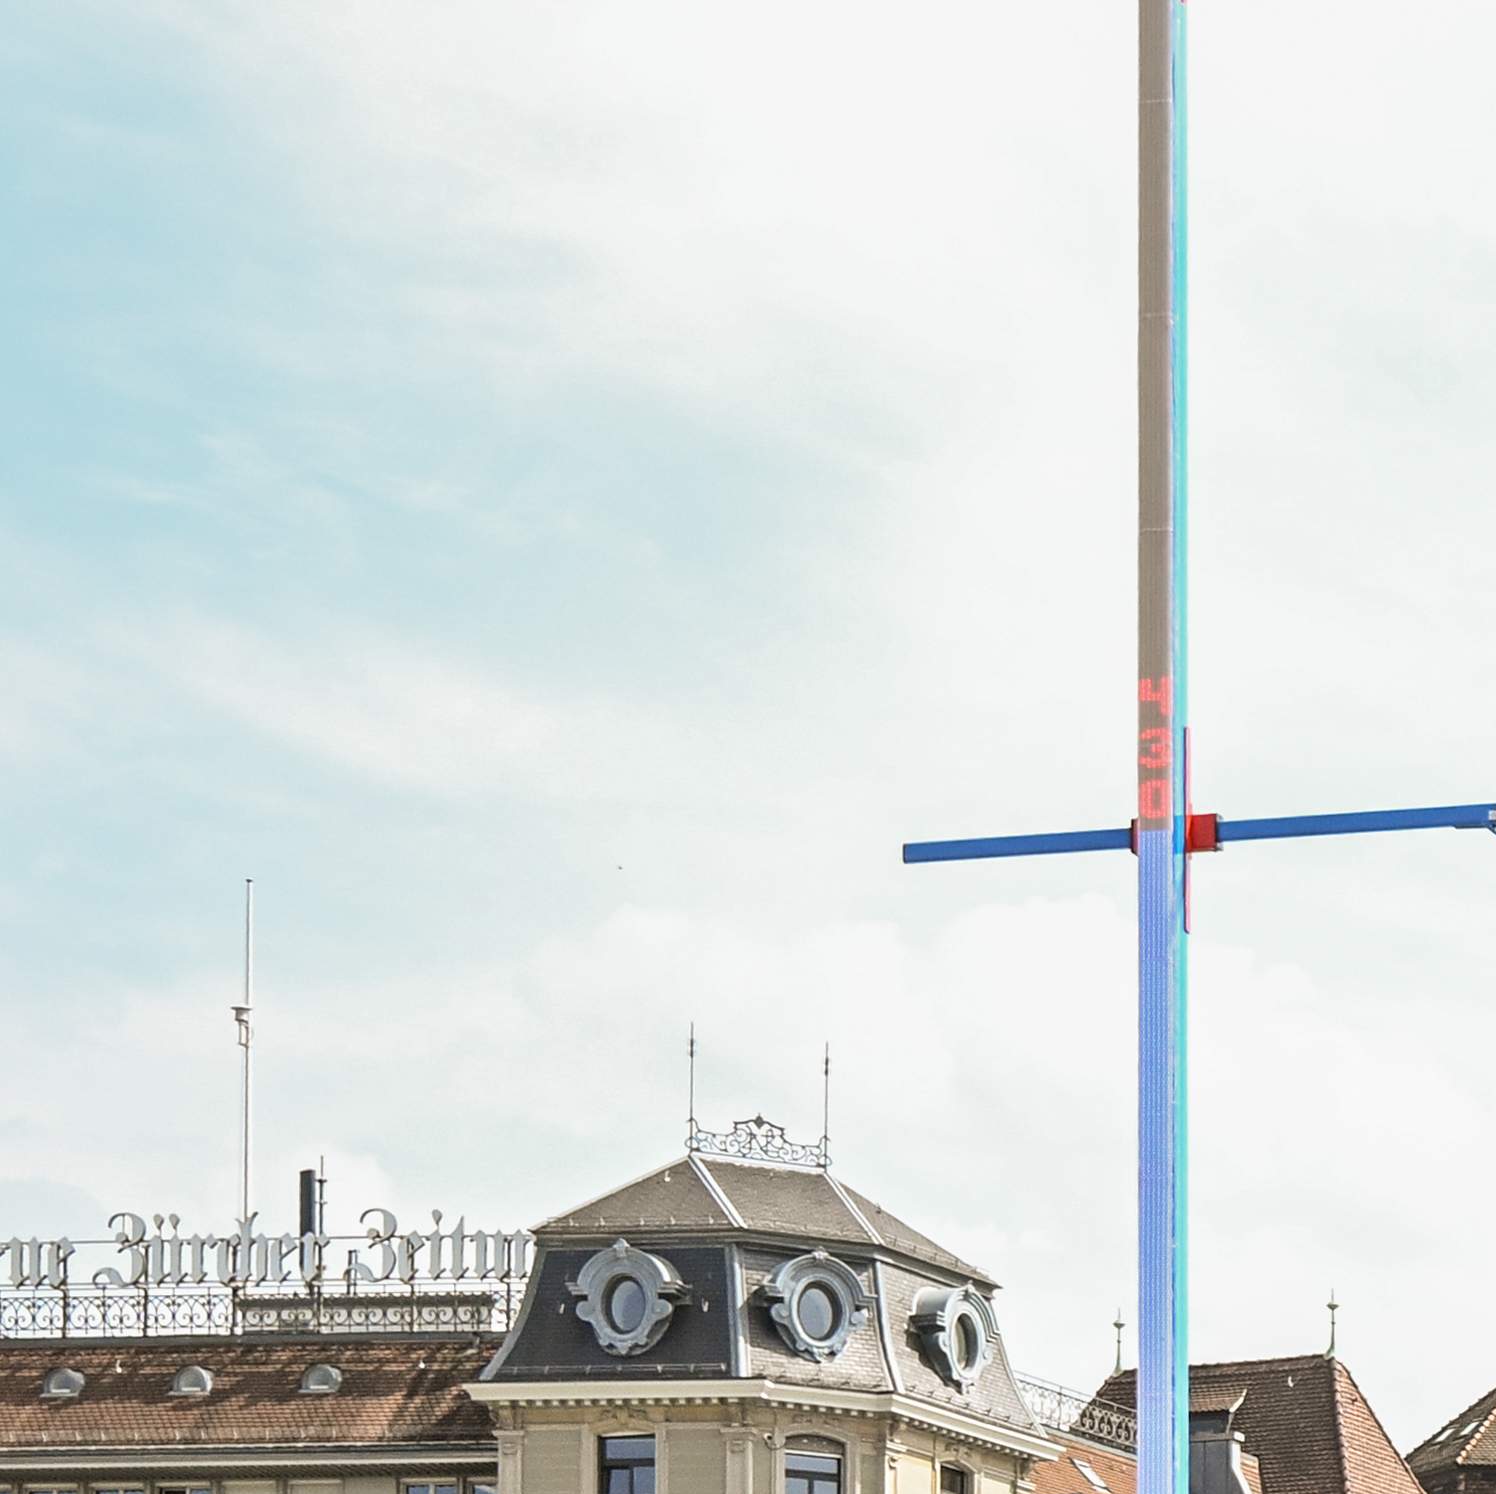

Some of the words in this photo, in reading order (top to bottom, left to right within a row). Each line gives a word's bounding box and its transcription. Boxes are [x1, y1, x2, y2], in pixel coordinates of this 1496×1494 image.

[0, 1236, 76, 1289] ue
[92, 1211, 330, 1288] Zürcher
[343, 1208, 531, 1283] Zeitun
